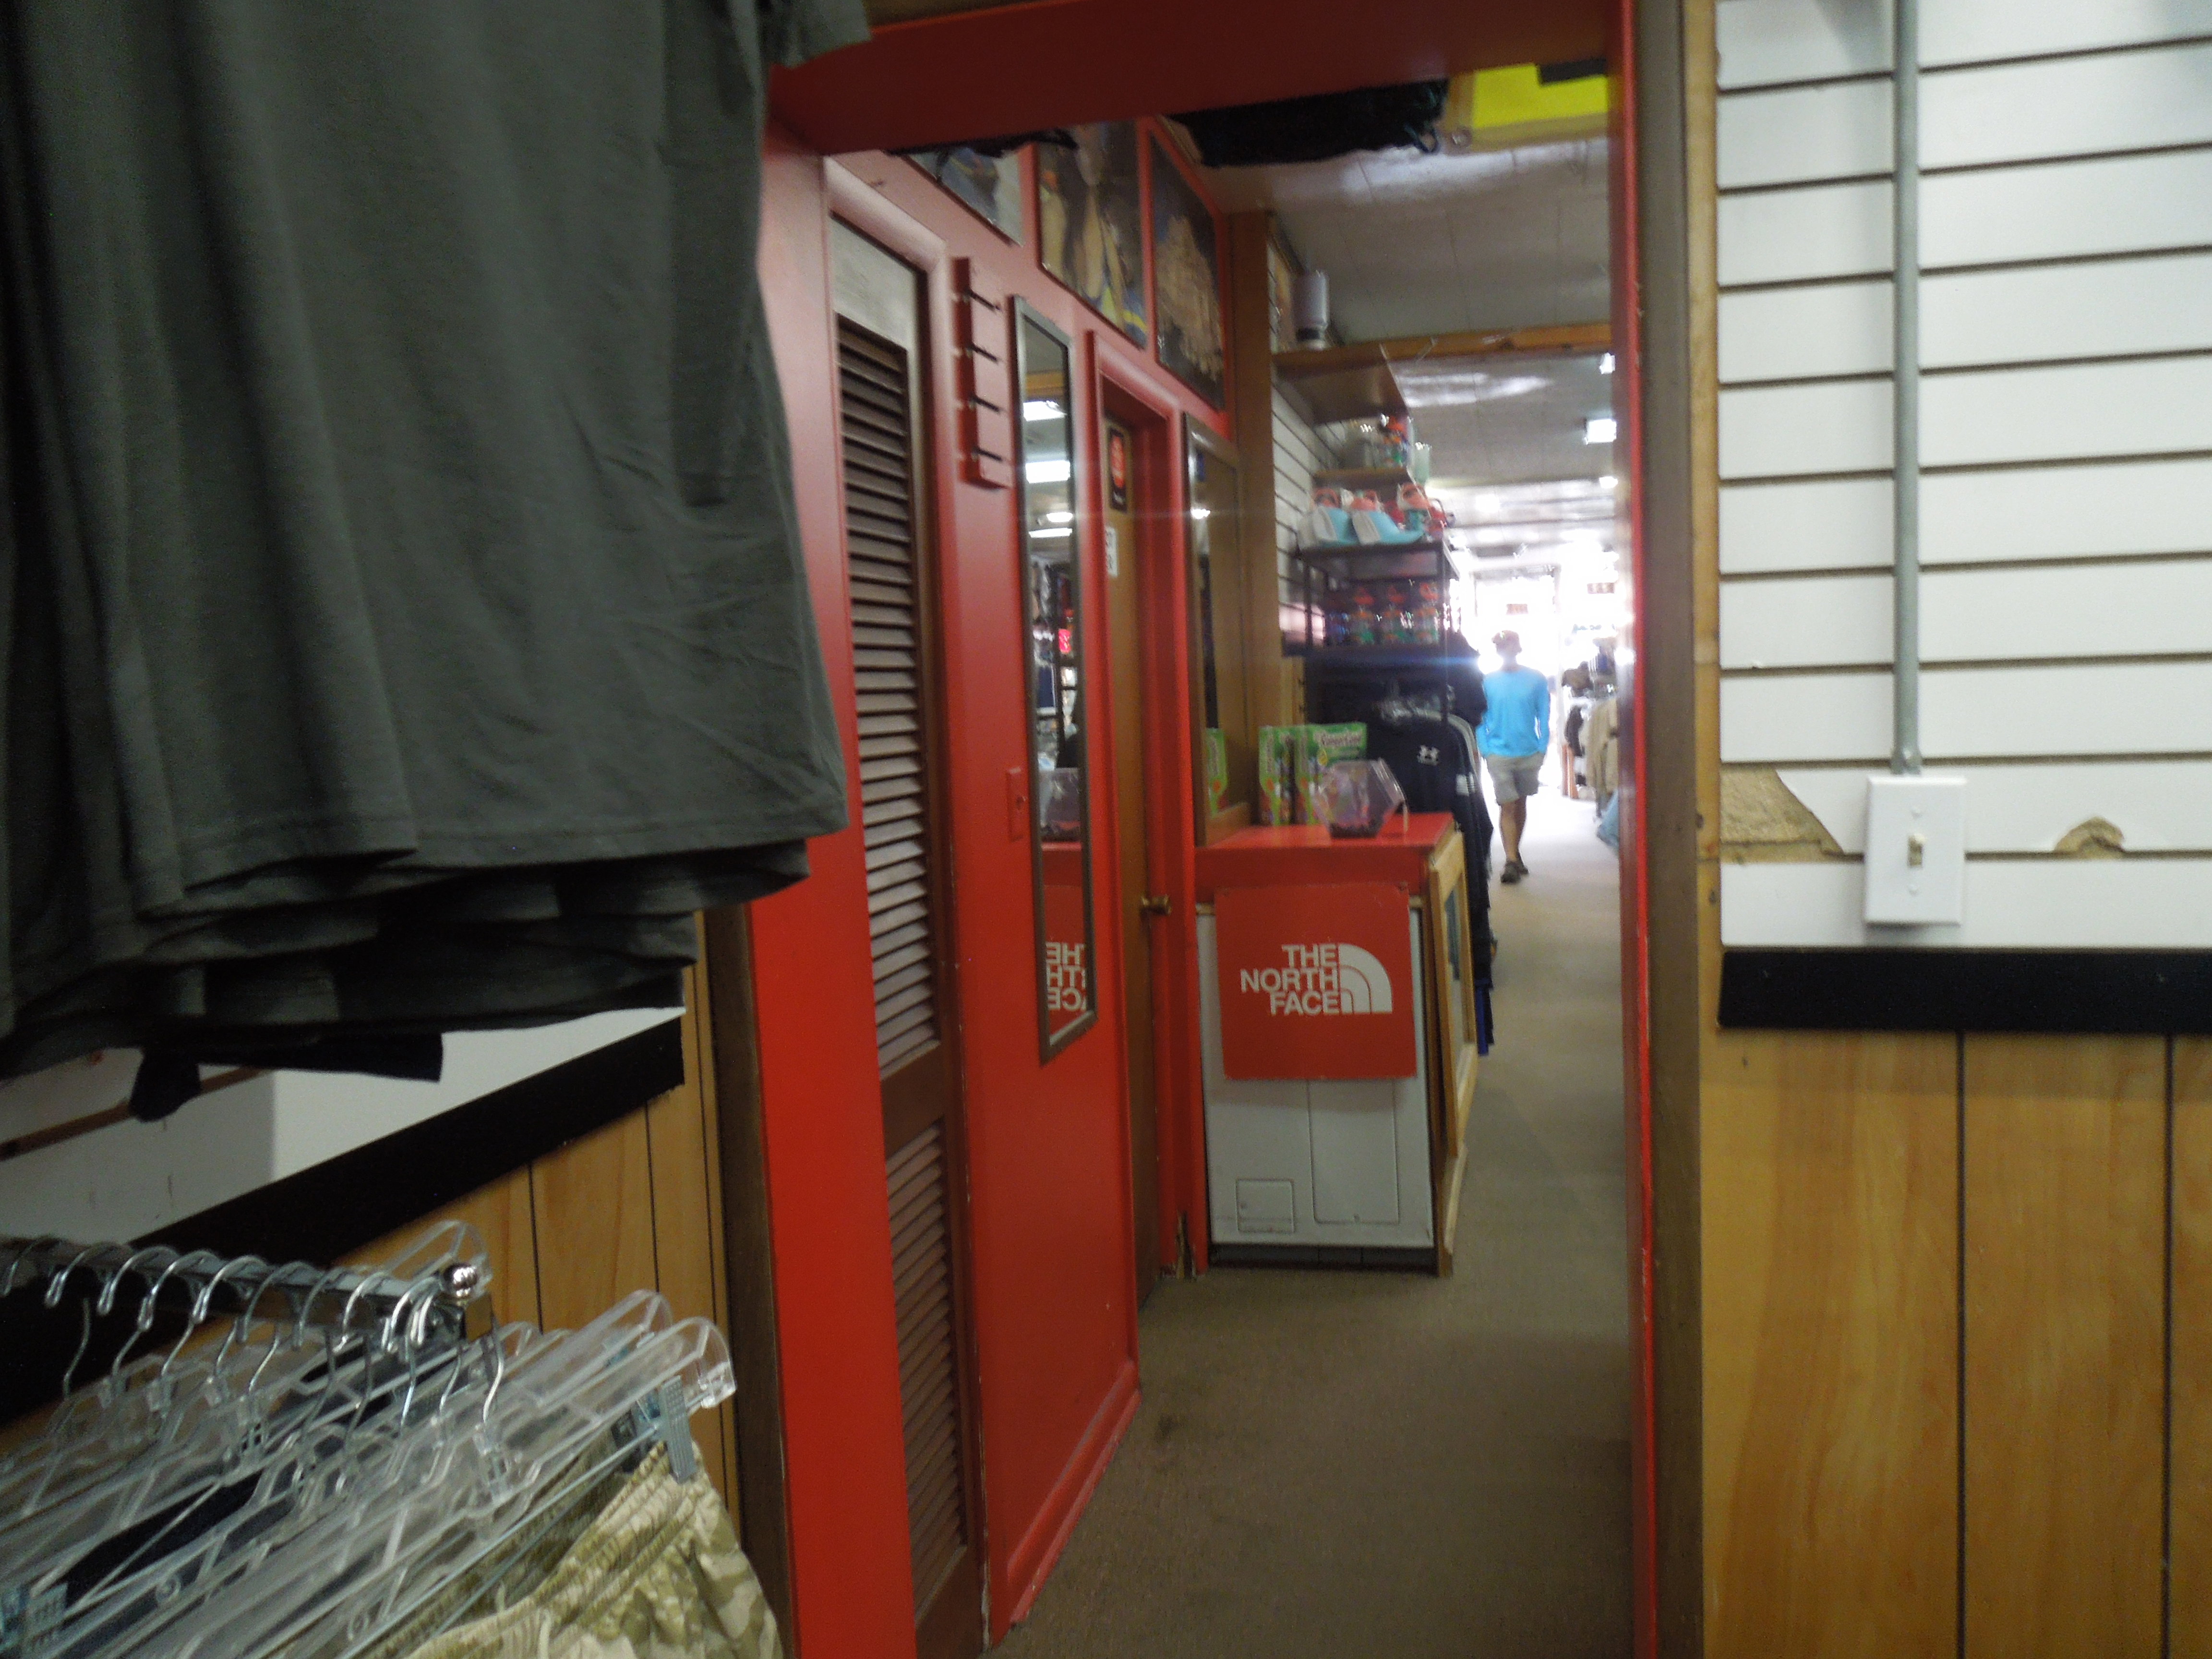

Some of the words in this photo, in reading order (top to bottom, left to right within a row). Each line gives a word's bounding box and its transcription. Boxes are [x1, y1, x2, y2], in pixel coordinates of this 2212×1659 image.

[1281, 943, 1337, 968] THE
[1239, 966, 1338, 993] NORTH
[1269, 990, 1340, 1016] FACE
